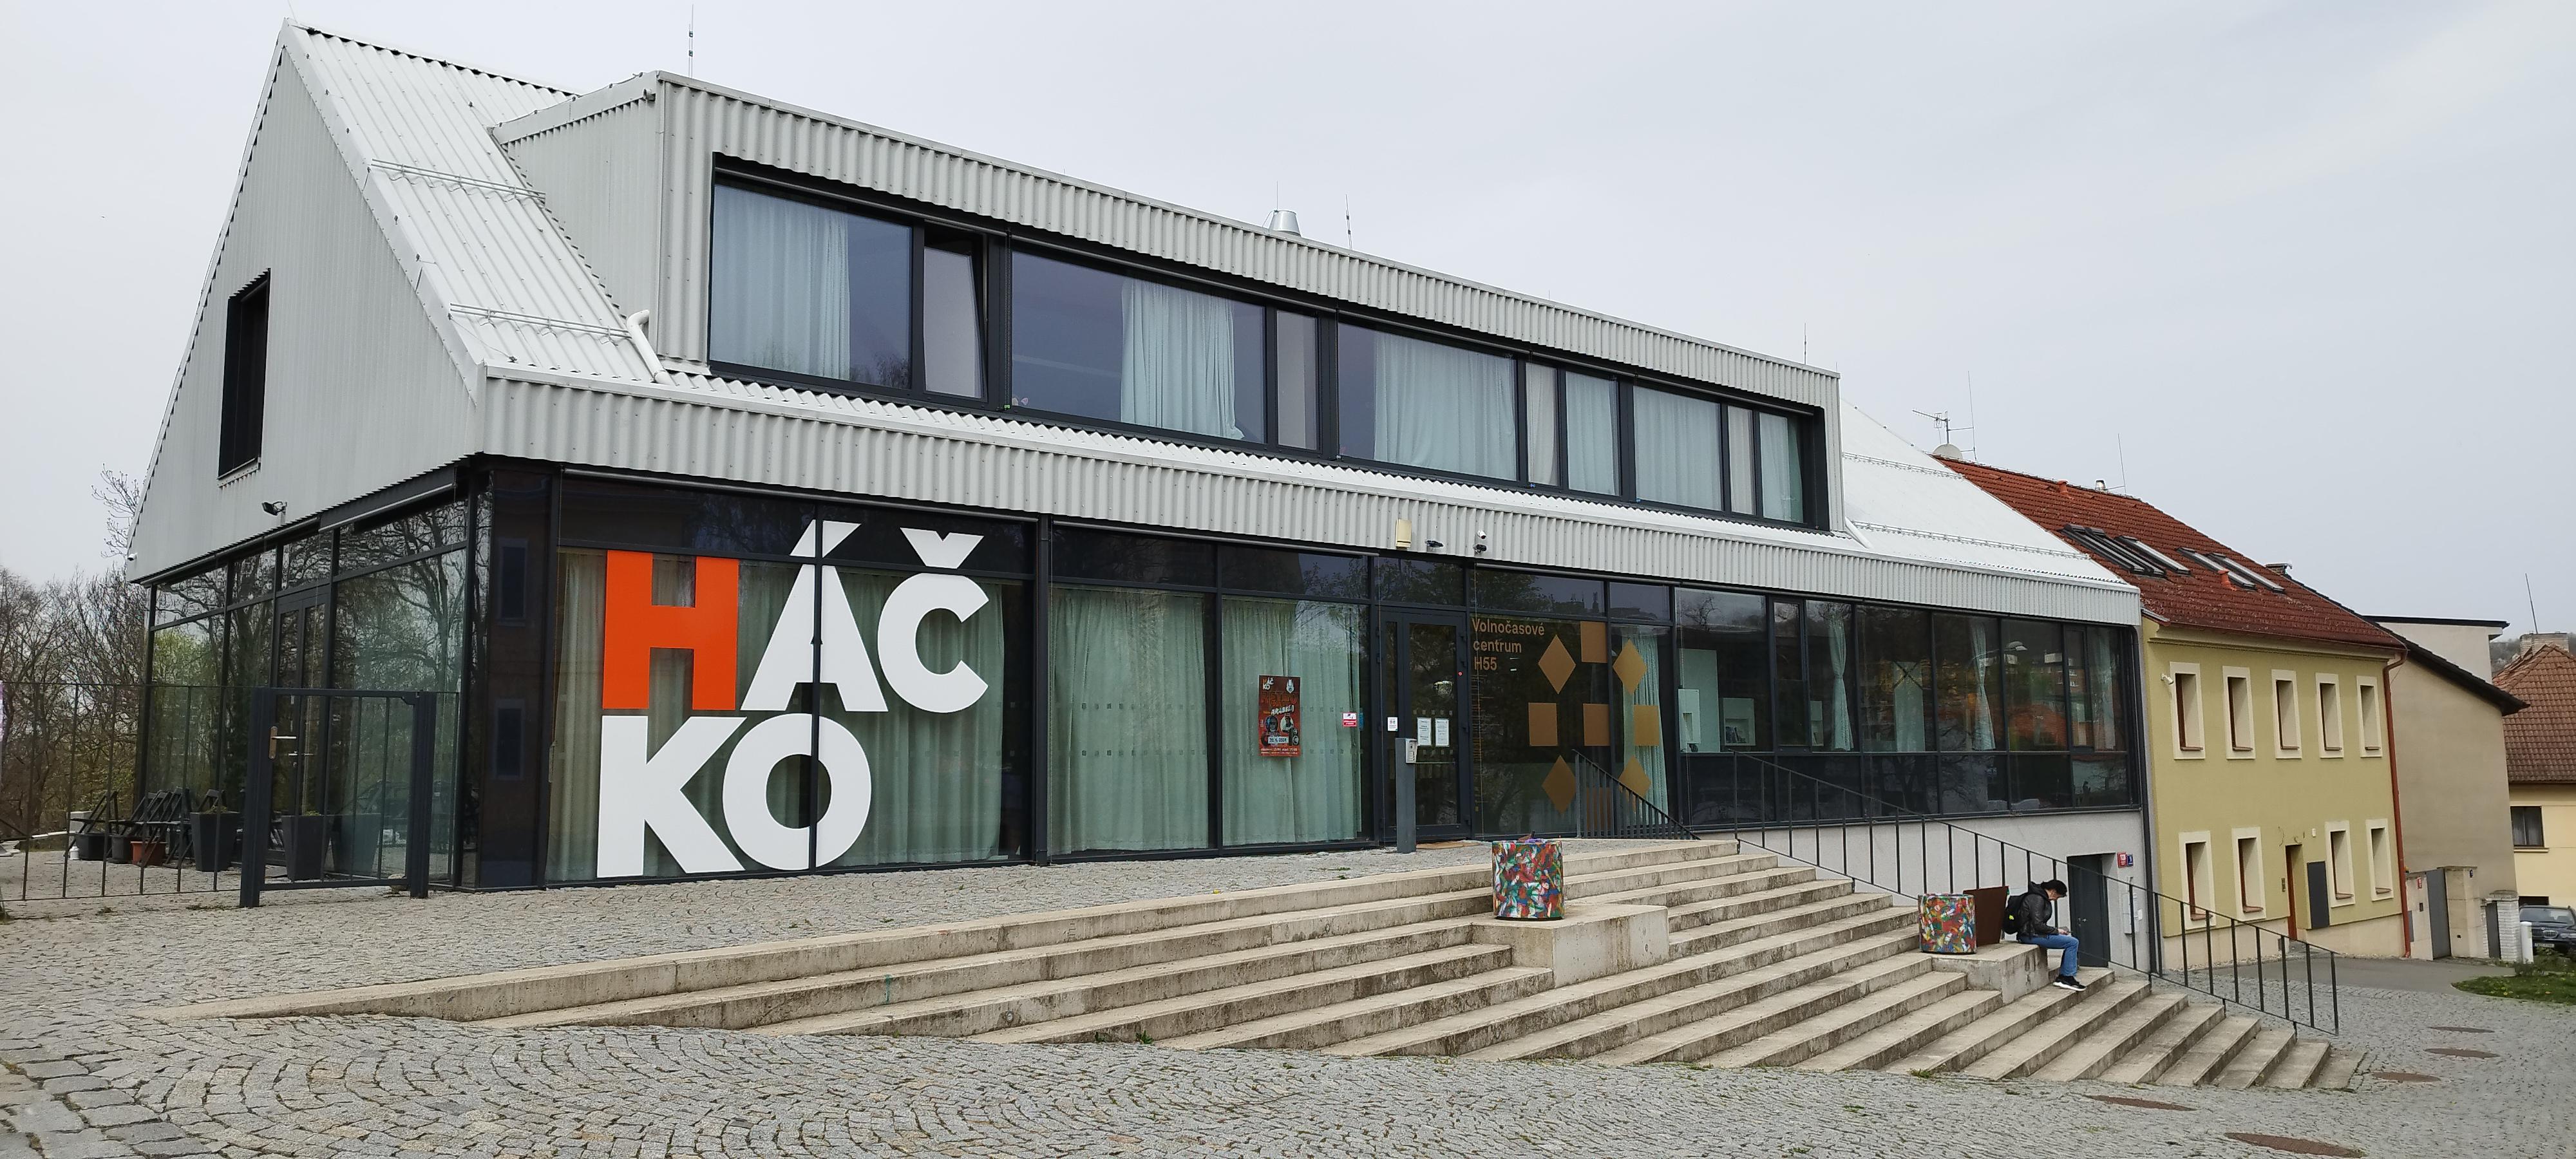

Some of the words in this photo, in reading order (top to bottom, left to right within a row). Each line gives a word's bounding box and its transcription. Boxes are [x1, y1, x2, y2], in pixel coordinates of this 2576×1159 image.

[602, 520, 989, 713] HÁČ
[1472, 618, 1545, 636] Volnočasové
[1473, 639, 1522, 653] centrum
[1473, 656, 1497, 671] H55
[596, 713, 871, 878] KO
